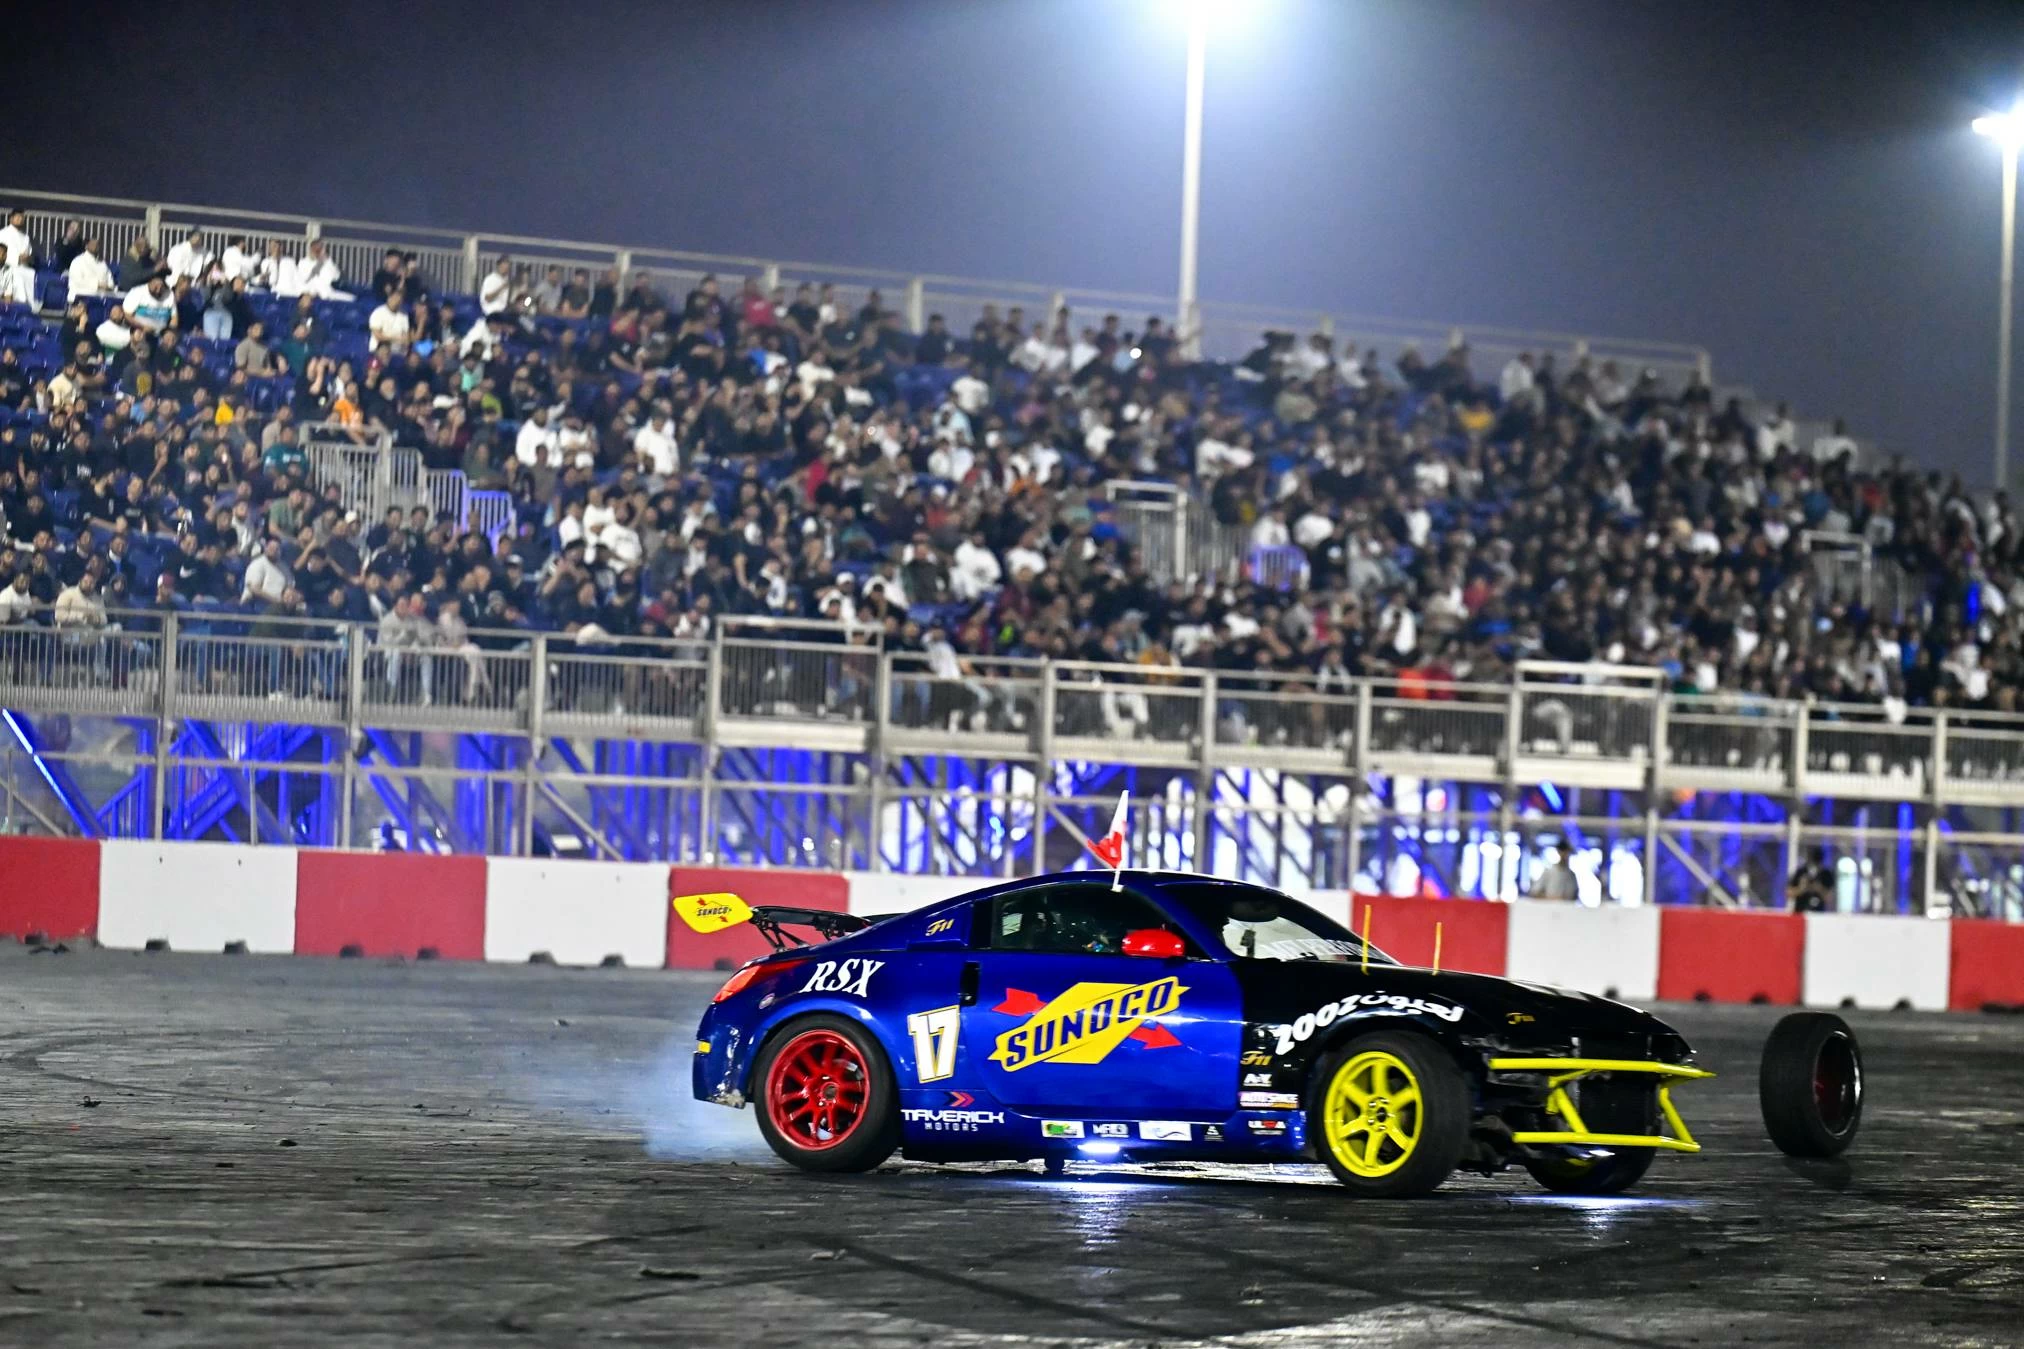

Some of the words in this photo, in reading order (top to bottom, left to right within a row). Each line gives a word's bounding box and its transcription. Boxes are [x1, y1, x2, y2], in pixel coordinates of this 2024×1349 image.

[697, 906, 729, 917] SUNOCO
[799, 958, 886, 998] RSX
[1005, 981, 1174, 1068] SUNOCO
[907, 1004, 960, 1084] 17
[900, 1108, 1005, 1124] MAVERICK
[924, 1122, 979, 1132] MOTORS
